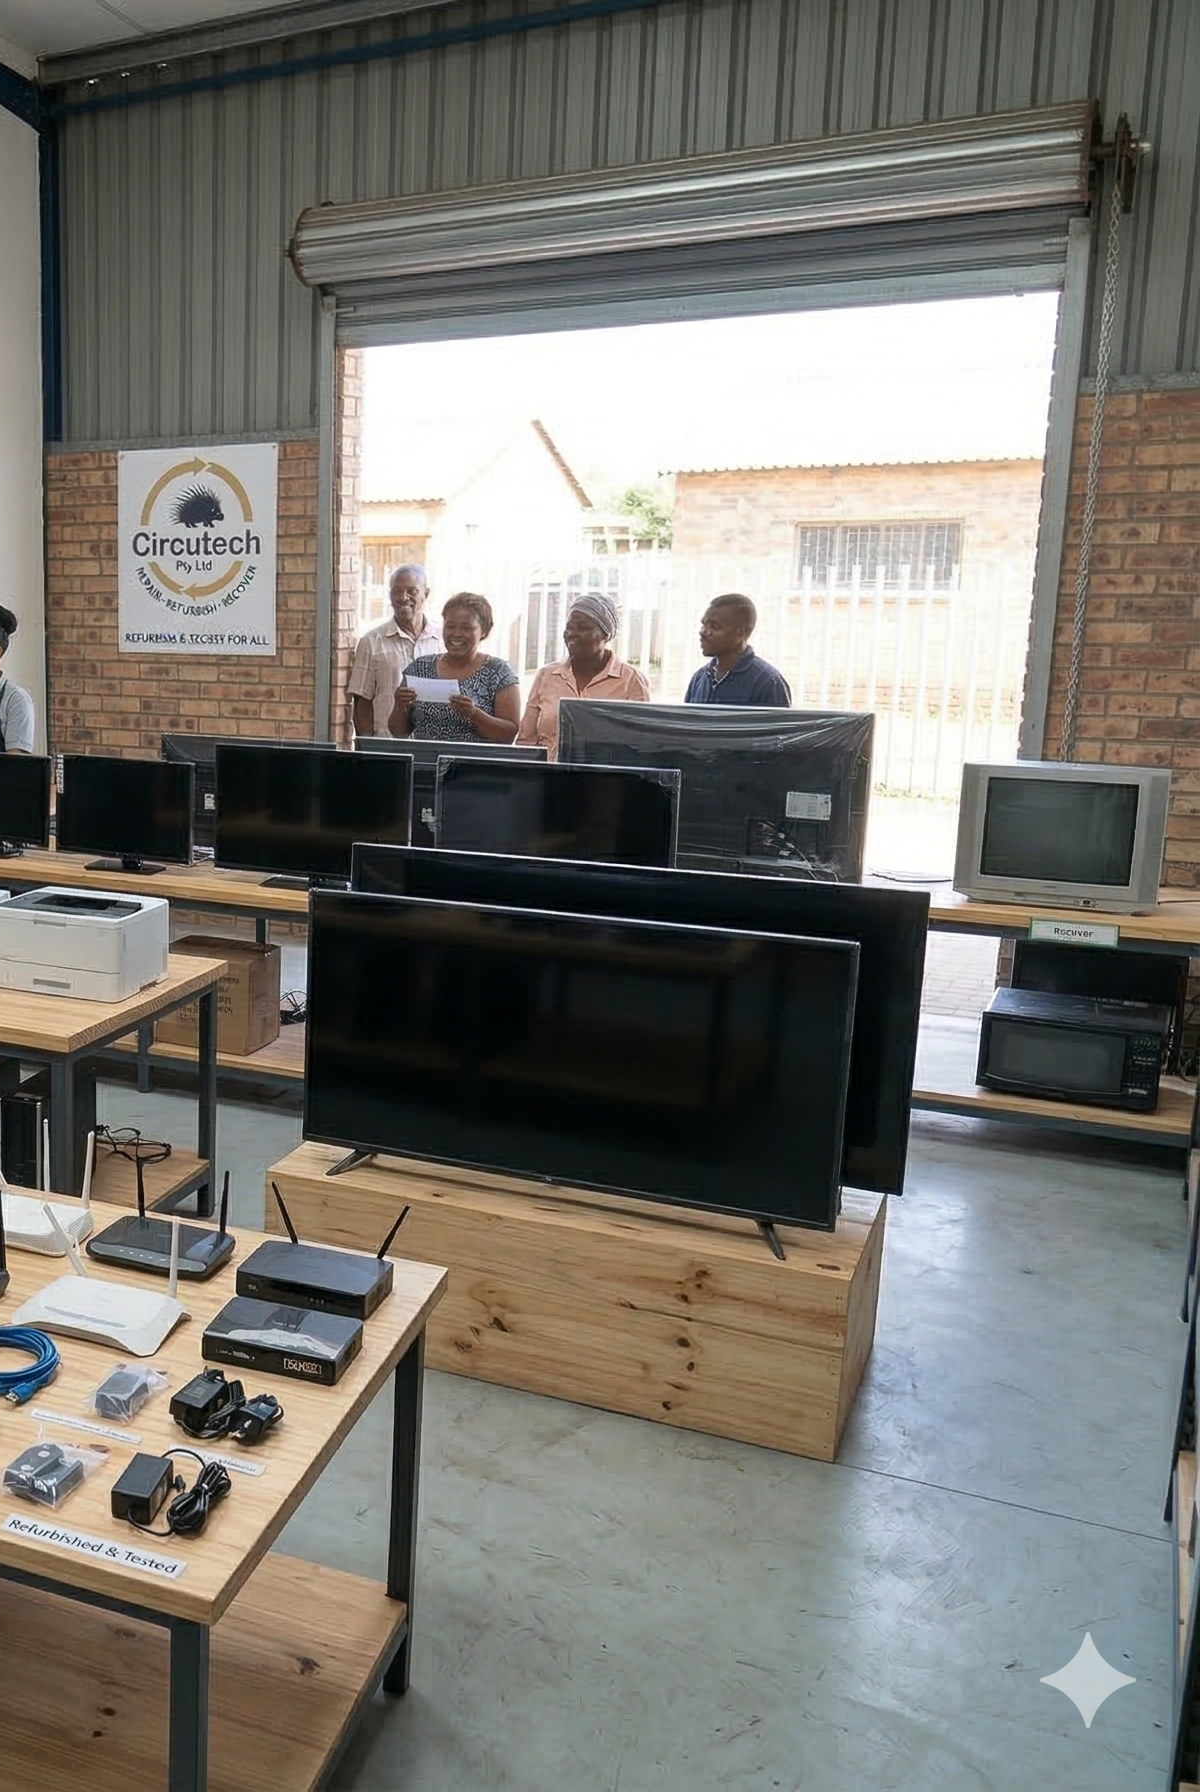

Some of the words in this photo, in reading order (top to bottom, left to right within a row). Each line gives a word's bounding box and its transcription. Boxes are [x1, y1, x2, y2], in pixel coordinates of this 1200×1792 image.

[132, 529, 261, 557] Circutech
[195, 560, 213, 571] Ltd
[227, 634, 248, 645] FOR
[250, 635, 270, 646] ALL
[8, 1519, 104, 1553] Refurbished
[105, 1546, 119, 1558] &
[124, 1550, 178, 1574] Tested
